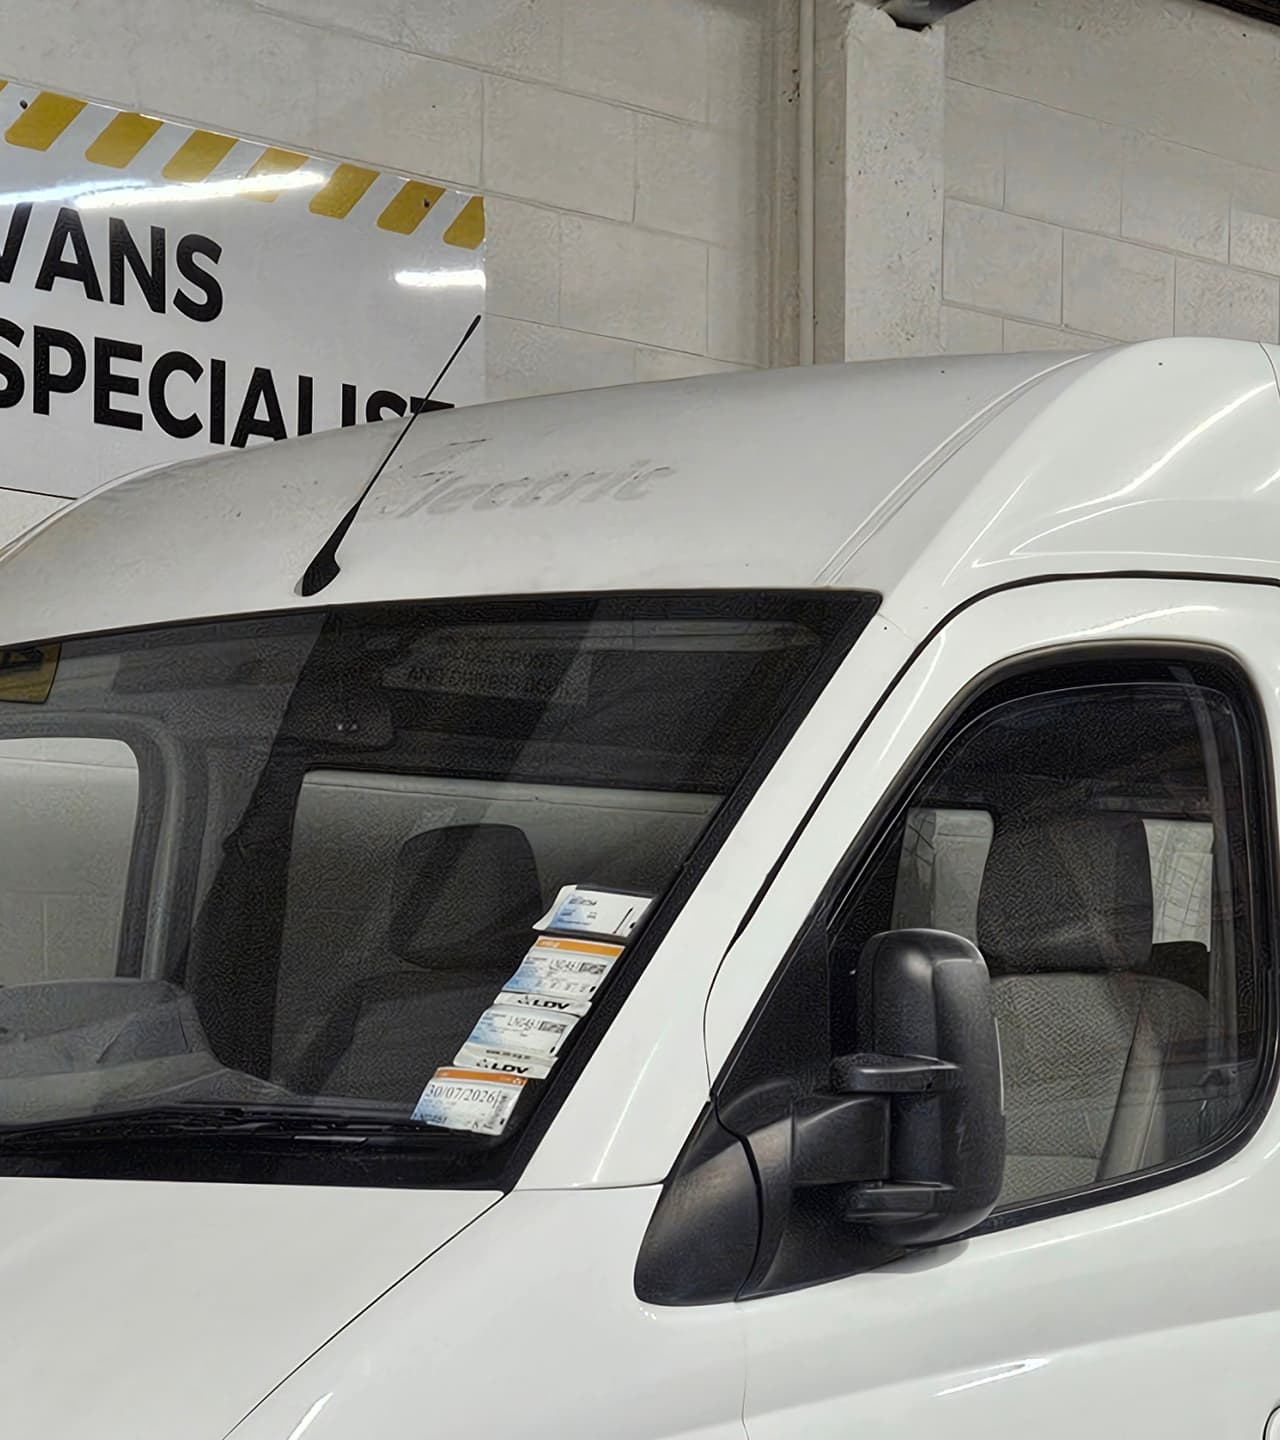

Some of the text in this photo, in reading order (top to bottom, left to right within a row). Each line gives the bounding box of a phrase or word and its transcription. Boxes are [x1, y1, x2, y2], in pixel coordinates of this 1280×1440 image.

[532, 998, 570, 1010] LDV
[491, 1062, 530, 1074] LDV
[426, 1083, 496, 1103] 30/07/2026
